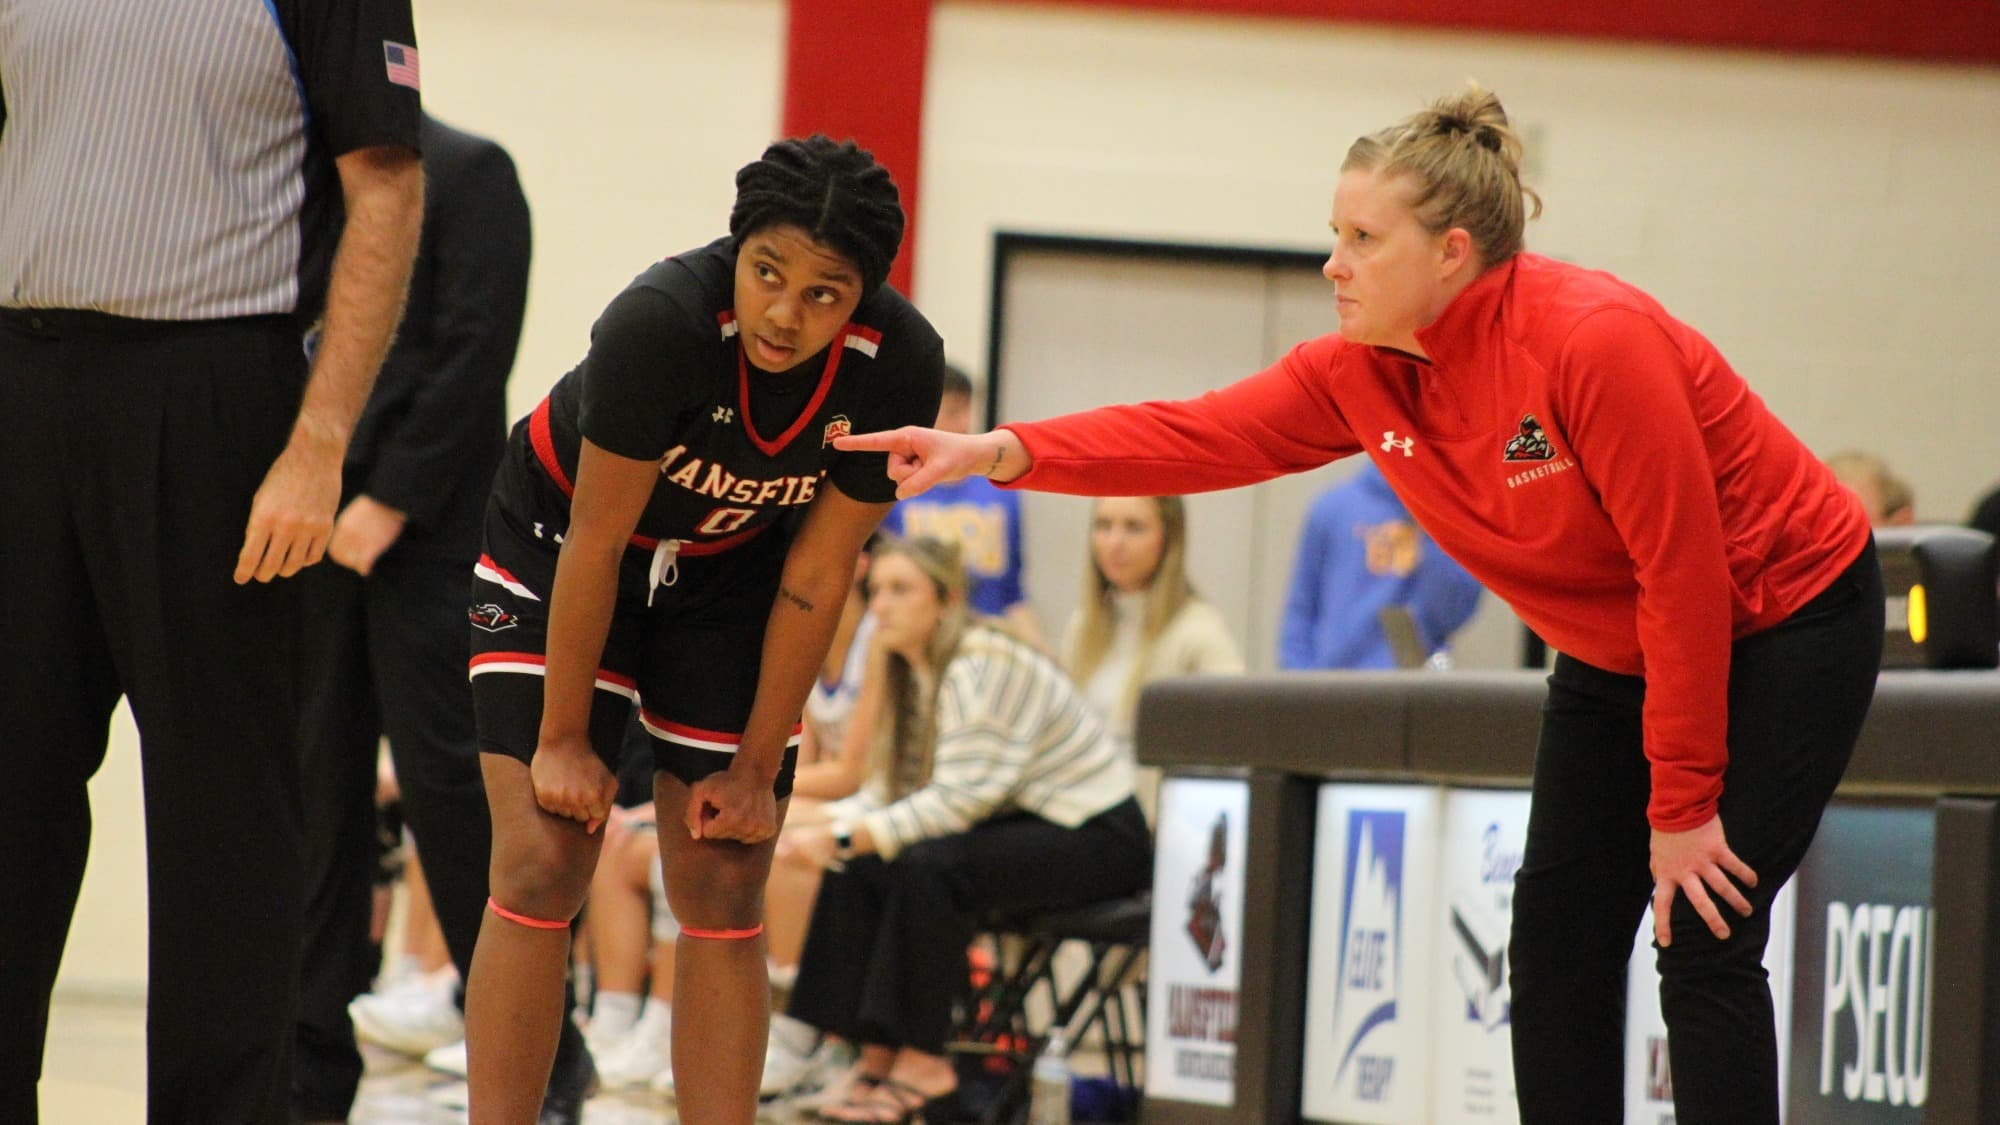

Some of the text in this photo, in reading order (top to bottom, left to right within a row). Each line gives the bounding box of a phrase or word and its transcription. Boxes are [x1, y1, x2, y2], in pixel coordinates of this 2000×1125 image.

[1506, 458, 1574, 489] BASKETBALL
[696, 507, 757, 534] 0
[1820, 901, 1934, 1107] PSECU
